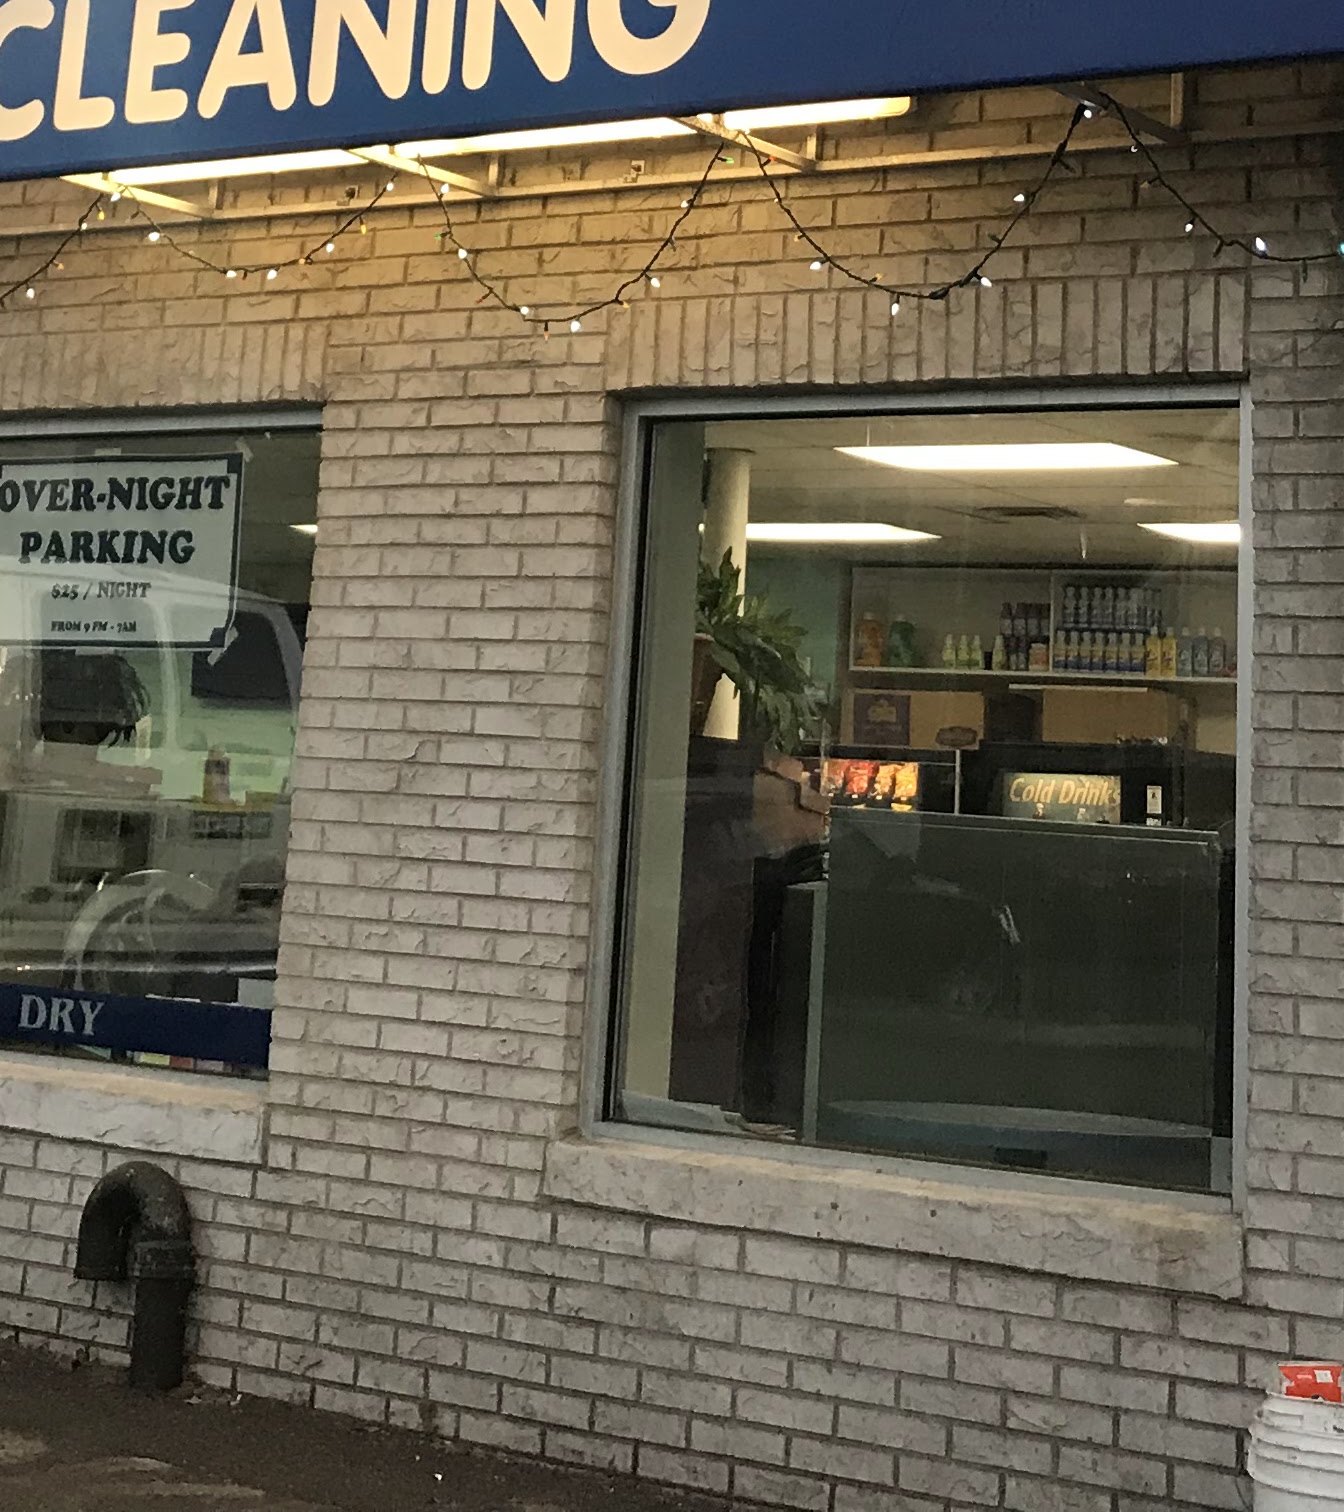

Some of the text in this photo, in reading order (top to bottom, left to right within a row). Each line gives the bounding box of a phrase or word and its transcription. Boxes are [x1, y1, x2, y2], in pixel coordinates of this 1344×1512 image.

[18, 529, 196, 564] PARKING
[96, 581, 152, 599] NIGHT
[51, 620, 81, 632] FROM
[1009, 777, 1056, 804] Cold
[17, 993, 105, 1037] DRY
